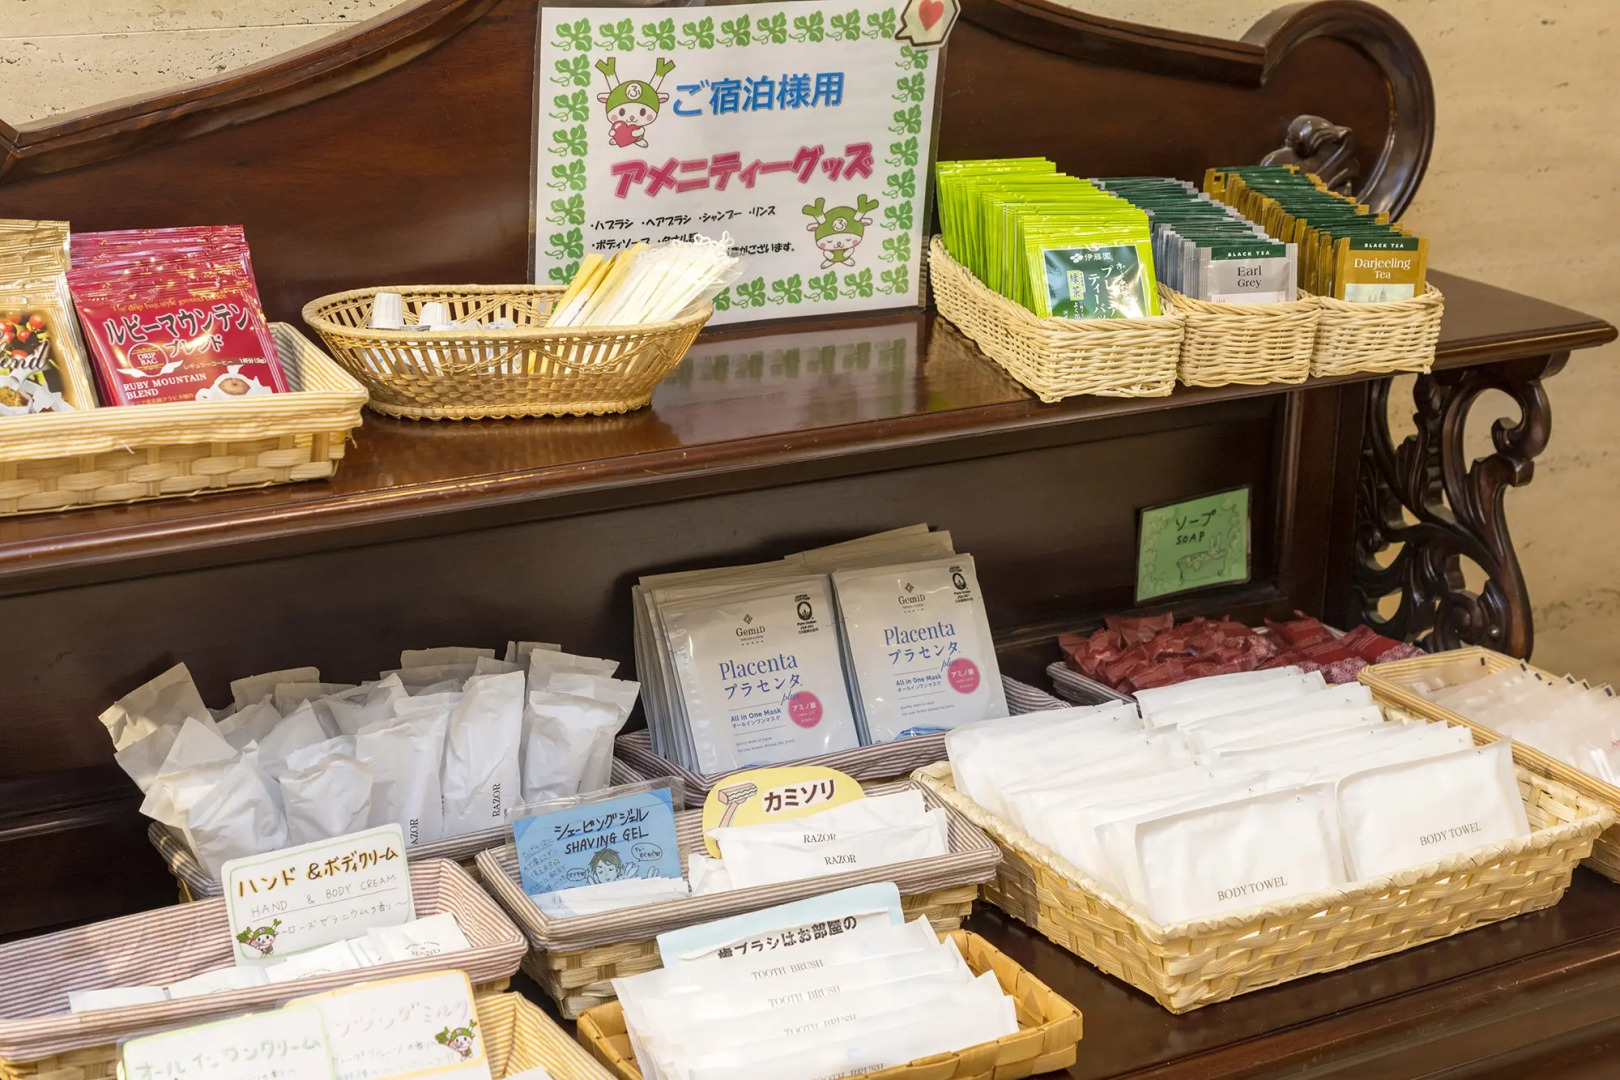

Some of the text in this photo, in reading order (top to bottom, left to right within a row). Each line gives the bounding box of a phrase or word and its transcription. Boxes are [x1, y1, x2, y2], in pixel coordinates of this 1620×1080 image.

[672, 71, 845, 118] ご宿泊様用
[608, 142, 874, 199] アメニティーグッズ
[1237, 265, 1262, 277] Earl
[1354, 257, 1411, 270] Darjeeling
[1373, 270, 1391, 279] Tea
[1237, 278, 1262, 288] Grey
[104, 304, 249, 346] ルビーマウンテン
[0, 340, 50, 370] end
[137, 351, 156, 361] DRIP
[164, 334, 224, 358] ブレンド
[140, 357, 159, 366] BAG
[123, 373, 207, 392] RUBY MOUNTAIN
[126, 388, 159, 400] BLEND
[1176, 509, 1217, 531] ソープ
[1176, 531, 1205, 545] SOAP
[735, 625, 766, 637] GemiD
[883, 621, 957, 646] Placenta
[888, 641, 959, 665] プラセンタ
[718, 653, 798, 681] Placenta
[724, 673, 801, 700] プラセンタ
[896, 678, 906, 686] All
[926, 673, 942, 682] Mask
[730, 713, 742, 722] All
[749, 710, 763, 719] One
[764, 707, 782, 717] Mask
[732, 715, 781, 728] オールインワンマスク
[492, 783, 501, 818] RAZOR
[764, 780, 836, 813] カミソリ
[410, 818, 419, 845] AZOR
[565, 832, 618, 855] SHAVING
[622, 825, 649, 840] GEL
[803, 833, 837, 844] RAZOR
[1418, 822, 1481, 846] BODY TOWEL
[824, 854, 857, 866] RAZOR
[237, 867, 296, 897] ハンド
[1217, 876, 1287, 901] BODY TOWEL
[251, 901, 288, 918] HAND
[326, 884, 351, 899] BODY
[360, 874, 397, 891] CREAM
[752, 959, 824, 980] TOOTH BRUSH
[768, 985, 841, 1008] TOOTH BRUSH
